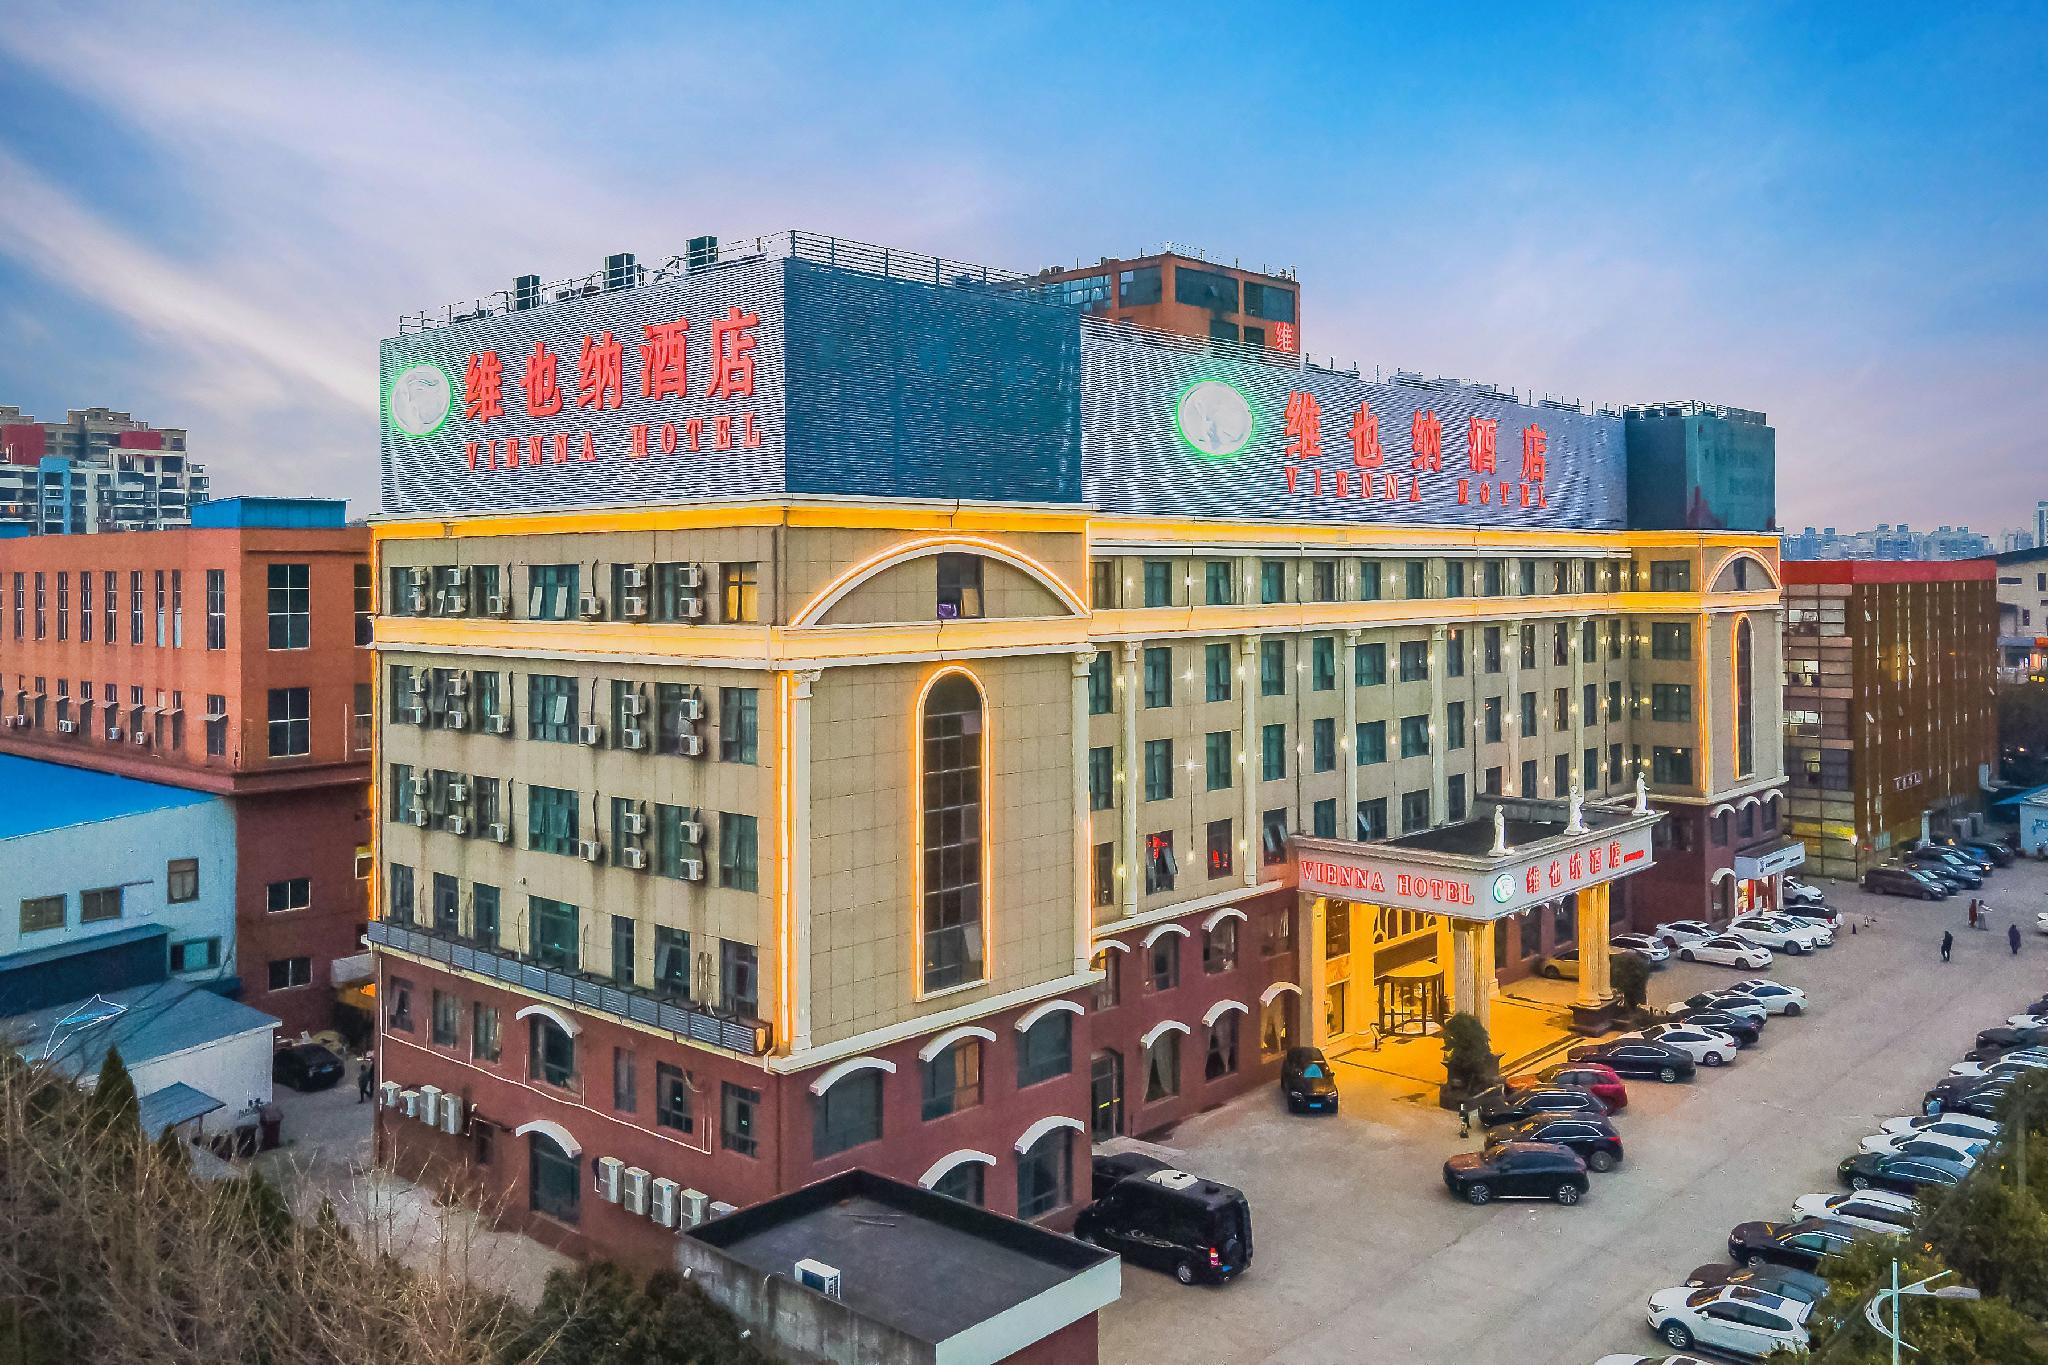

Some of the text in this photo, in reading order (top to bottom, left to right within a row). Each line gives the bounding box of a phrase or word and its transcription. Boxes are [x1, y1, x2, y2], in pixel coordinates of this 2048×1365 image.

[464, 305, 759, 423] 维也纳酒店
[465, 412, 761, 470] VIENNA HOTEL
[1284, 390, 1547, 482] 维也纳酒店
[1285, 466, 1547, 508] VIENNA HOTEL
[1301, 861, 1475, 905] VIENNA HOTEL
[1526, 840, 1621, 894] 维也纳酒店
